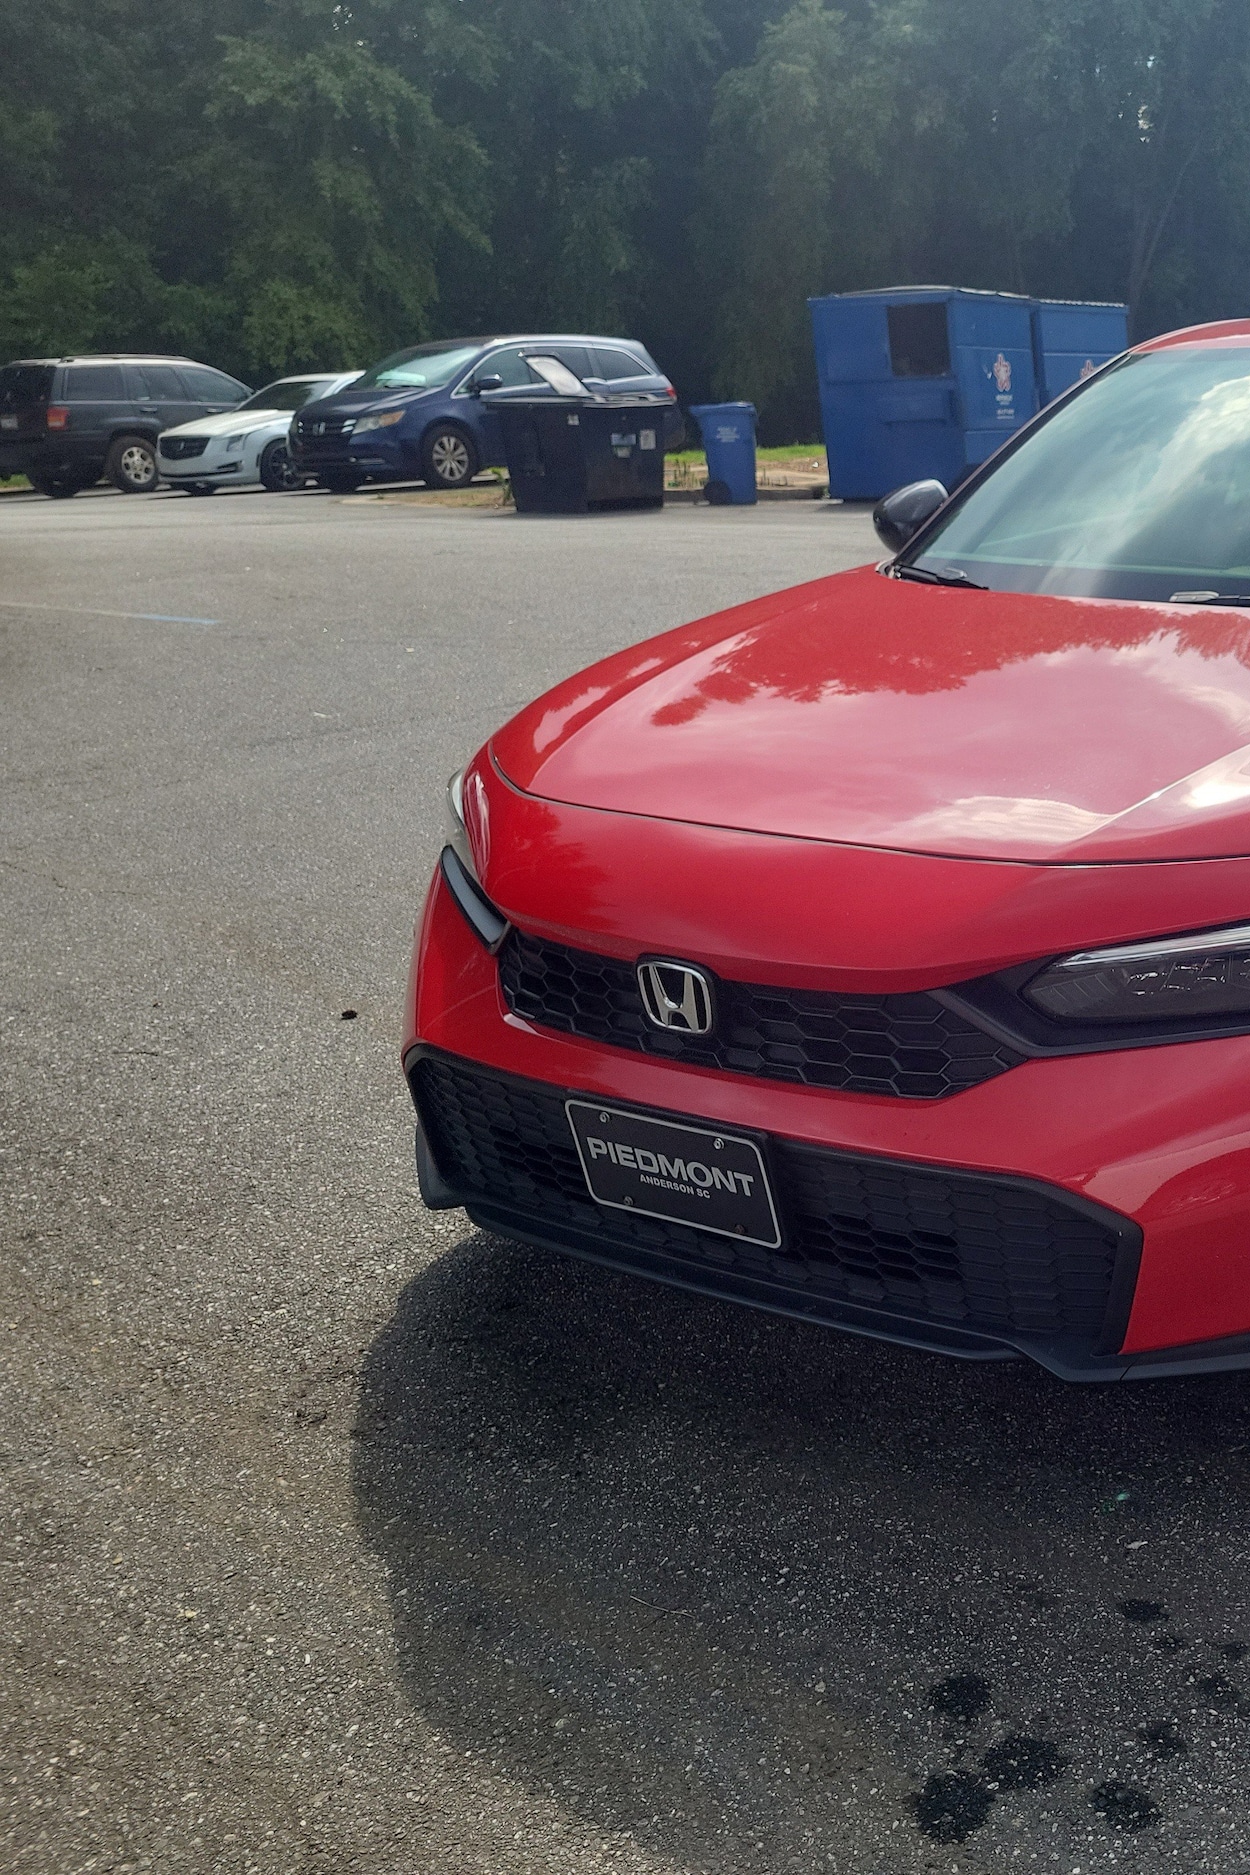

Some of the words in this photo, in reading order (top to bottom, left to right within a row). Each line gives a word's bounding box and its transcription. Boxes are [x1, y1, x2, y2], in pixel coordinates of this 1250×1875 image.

[586, 1136, 754, 1197] PIEDMONT
[640, 1173, 695, 1195] ANDERSON
[696, 1188, 711, 1199] SC
